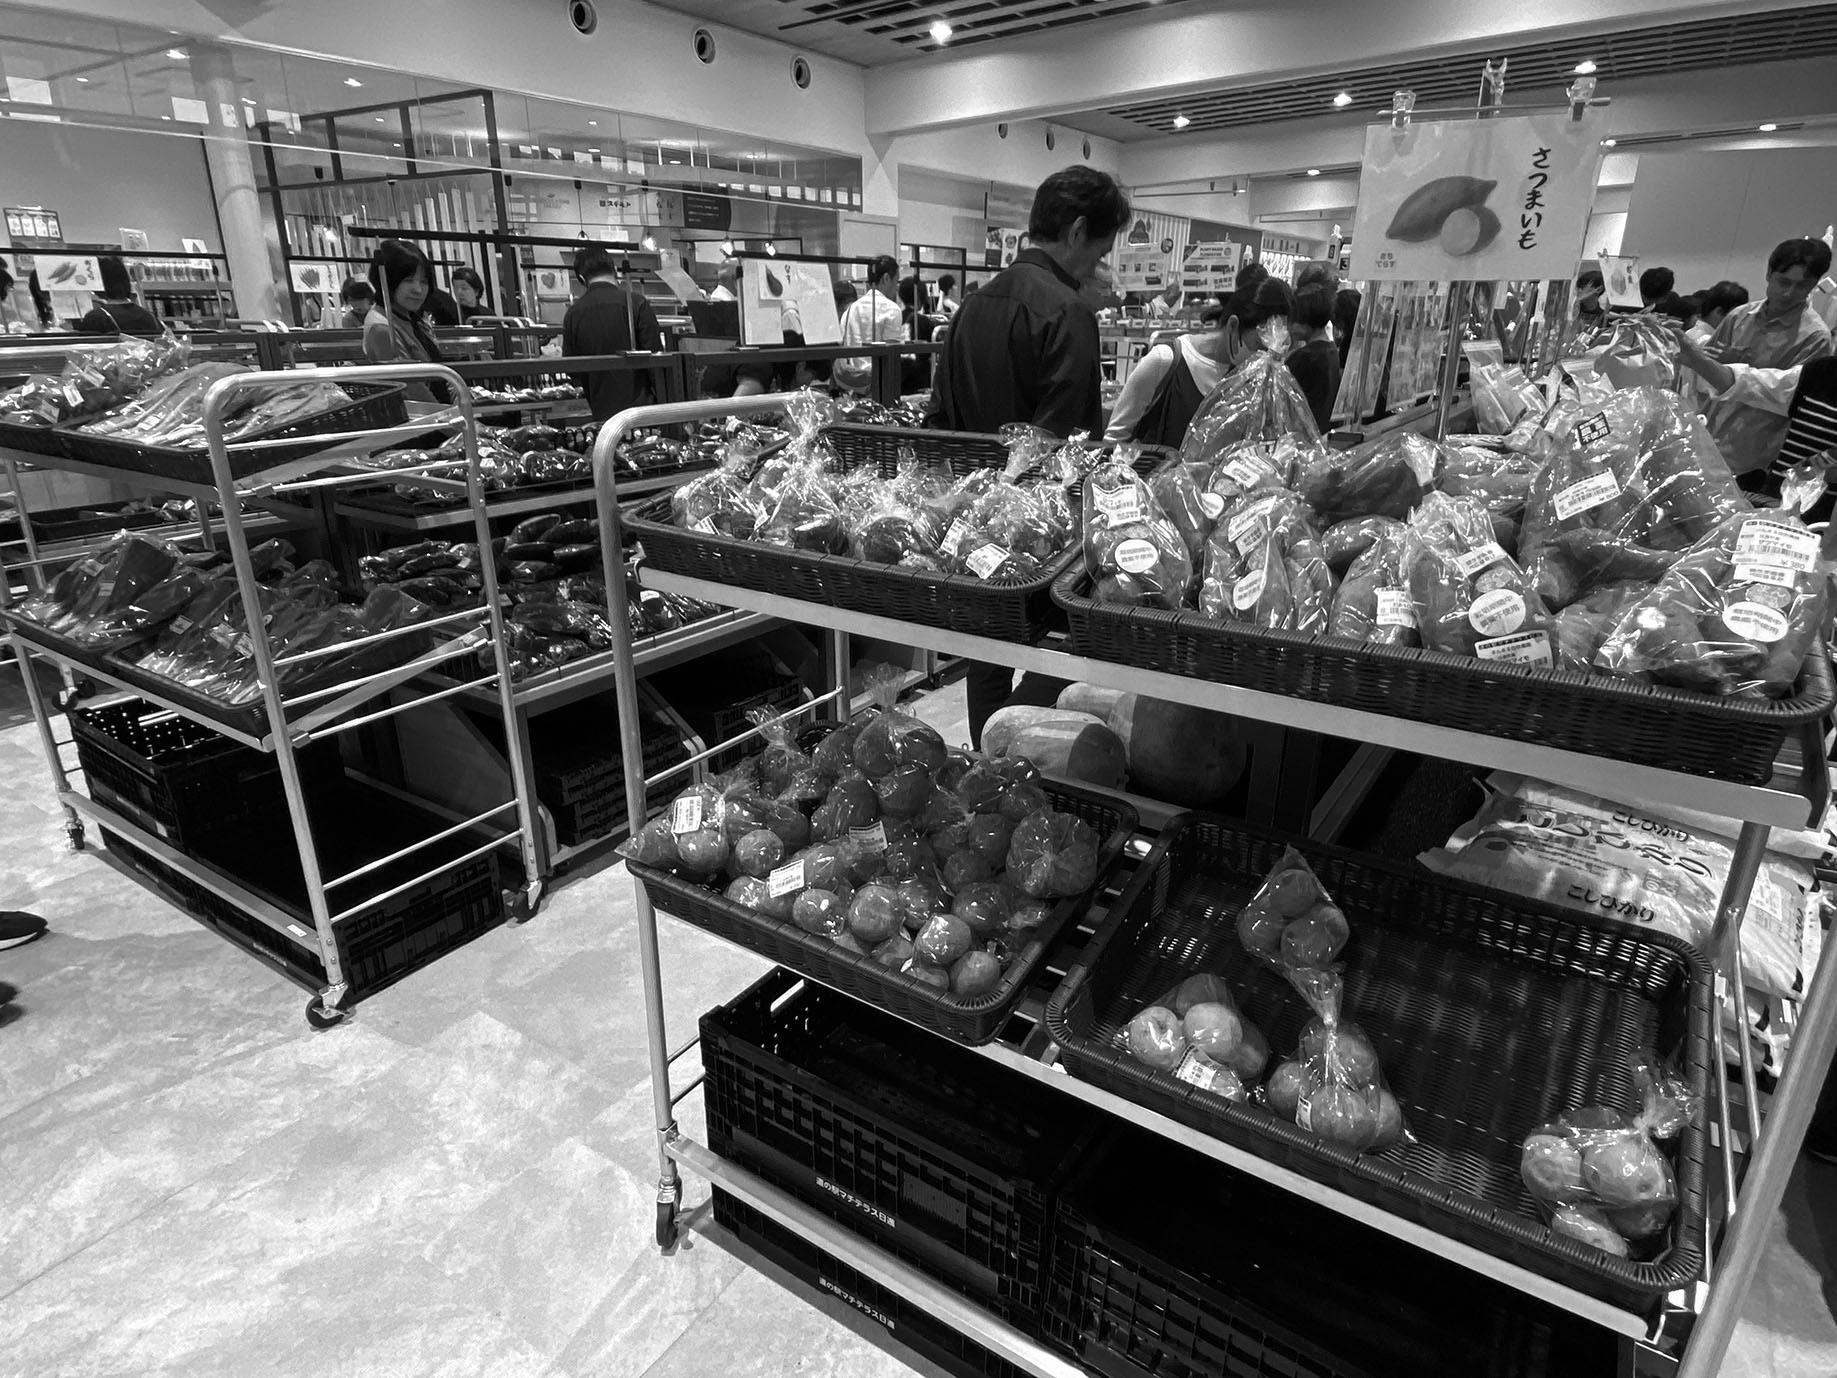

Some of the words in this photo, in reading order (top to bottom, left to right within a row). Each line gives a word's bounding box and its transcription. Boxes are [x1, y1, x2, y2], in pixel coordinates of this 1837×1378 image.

[1518, 147, 1551, 250] さつまいも
[1612, 809, 1689, 842] こしひかり
[1567, 884, 1655, 922] こしひかり
[815, 1176, 896, 1228] 道の駅マチテラス日進
